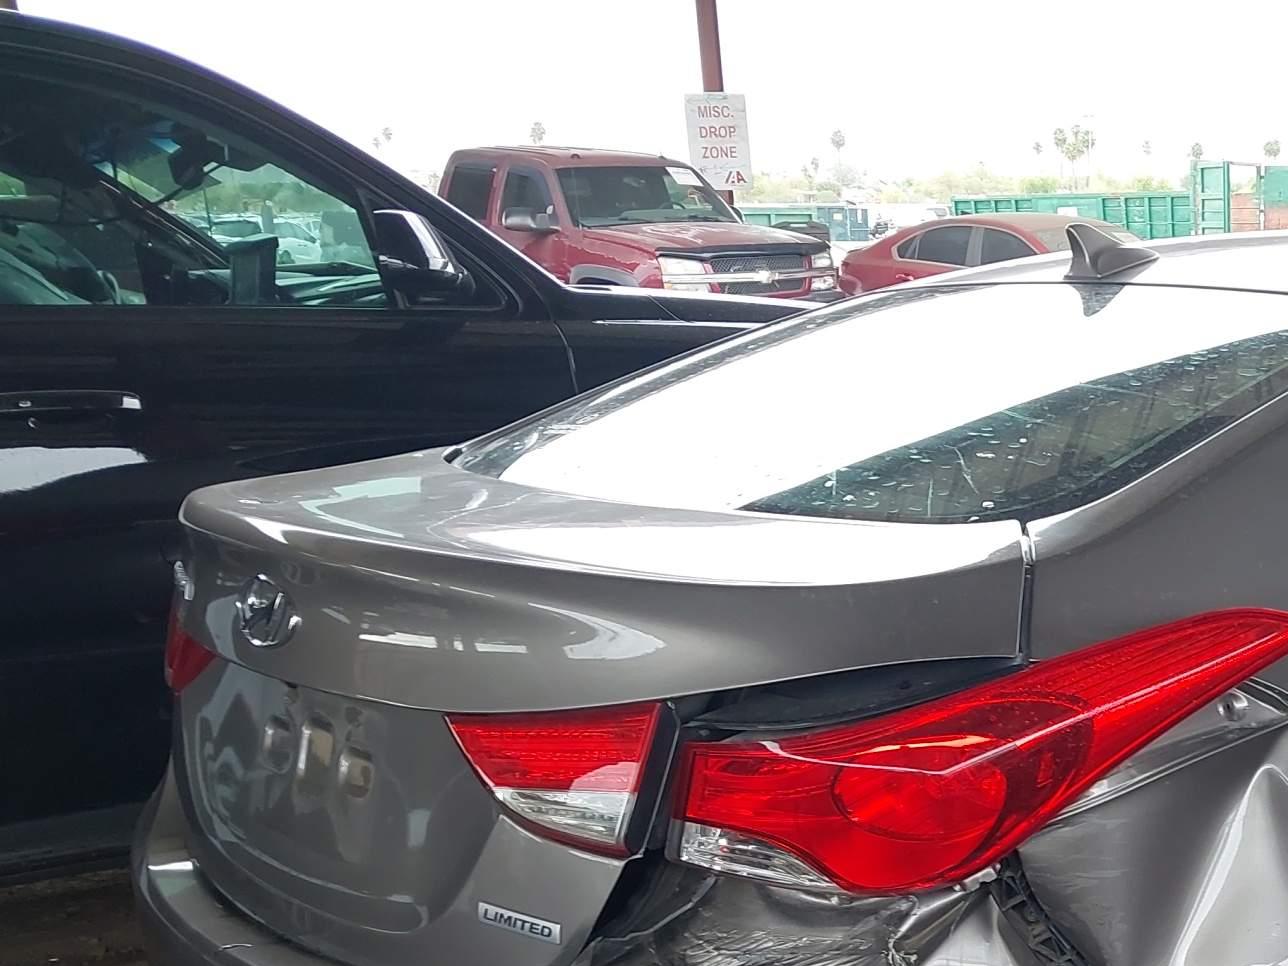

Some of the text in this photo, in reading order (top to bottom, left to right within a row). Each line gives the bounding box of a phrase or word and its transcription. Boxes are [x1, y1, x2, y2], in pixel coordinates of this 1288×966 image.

[697, 105, 734, 119] MISC.
[698, 125, 737, 139] DROP
[701, 146, 738, 160] ZONE
[483, 908, 552, 938] LIMITED
